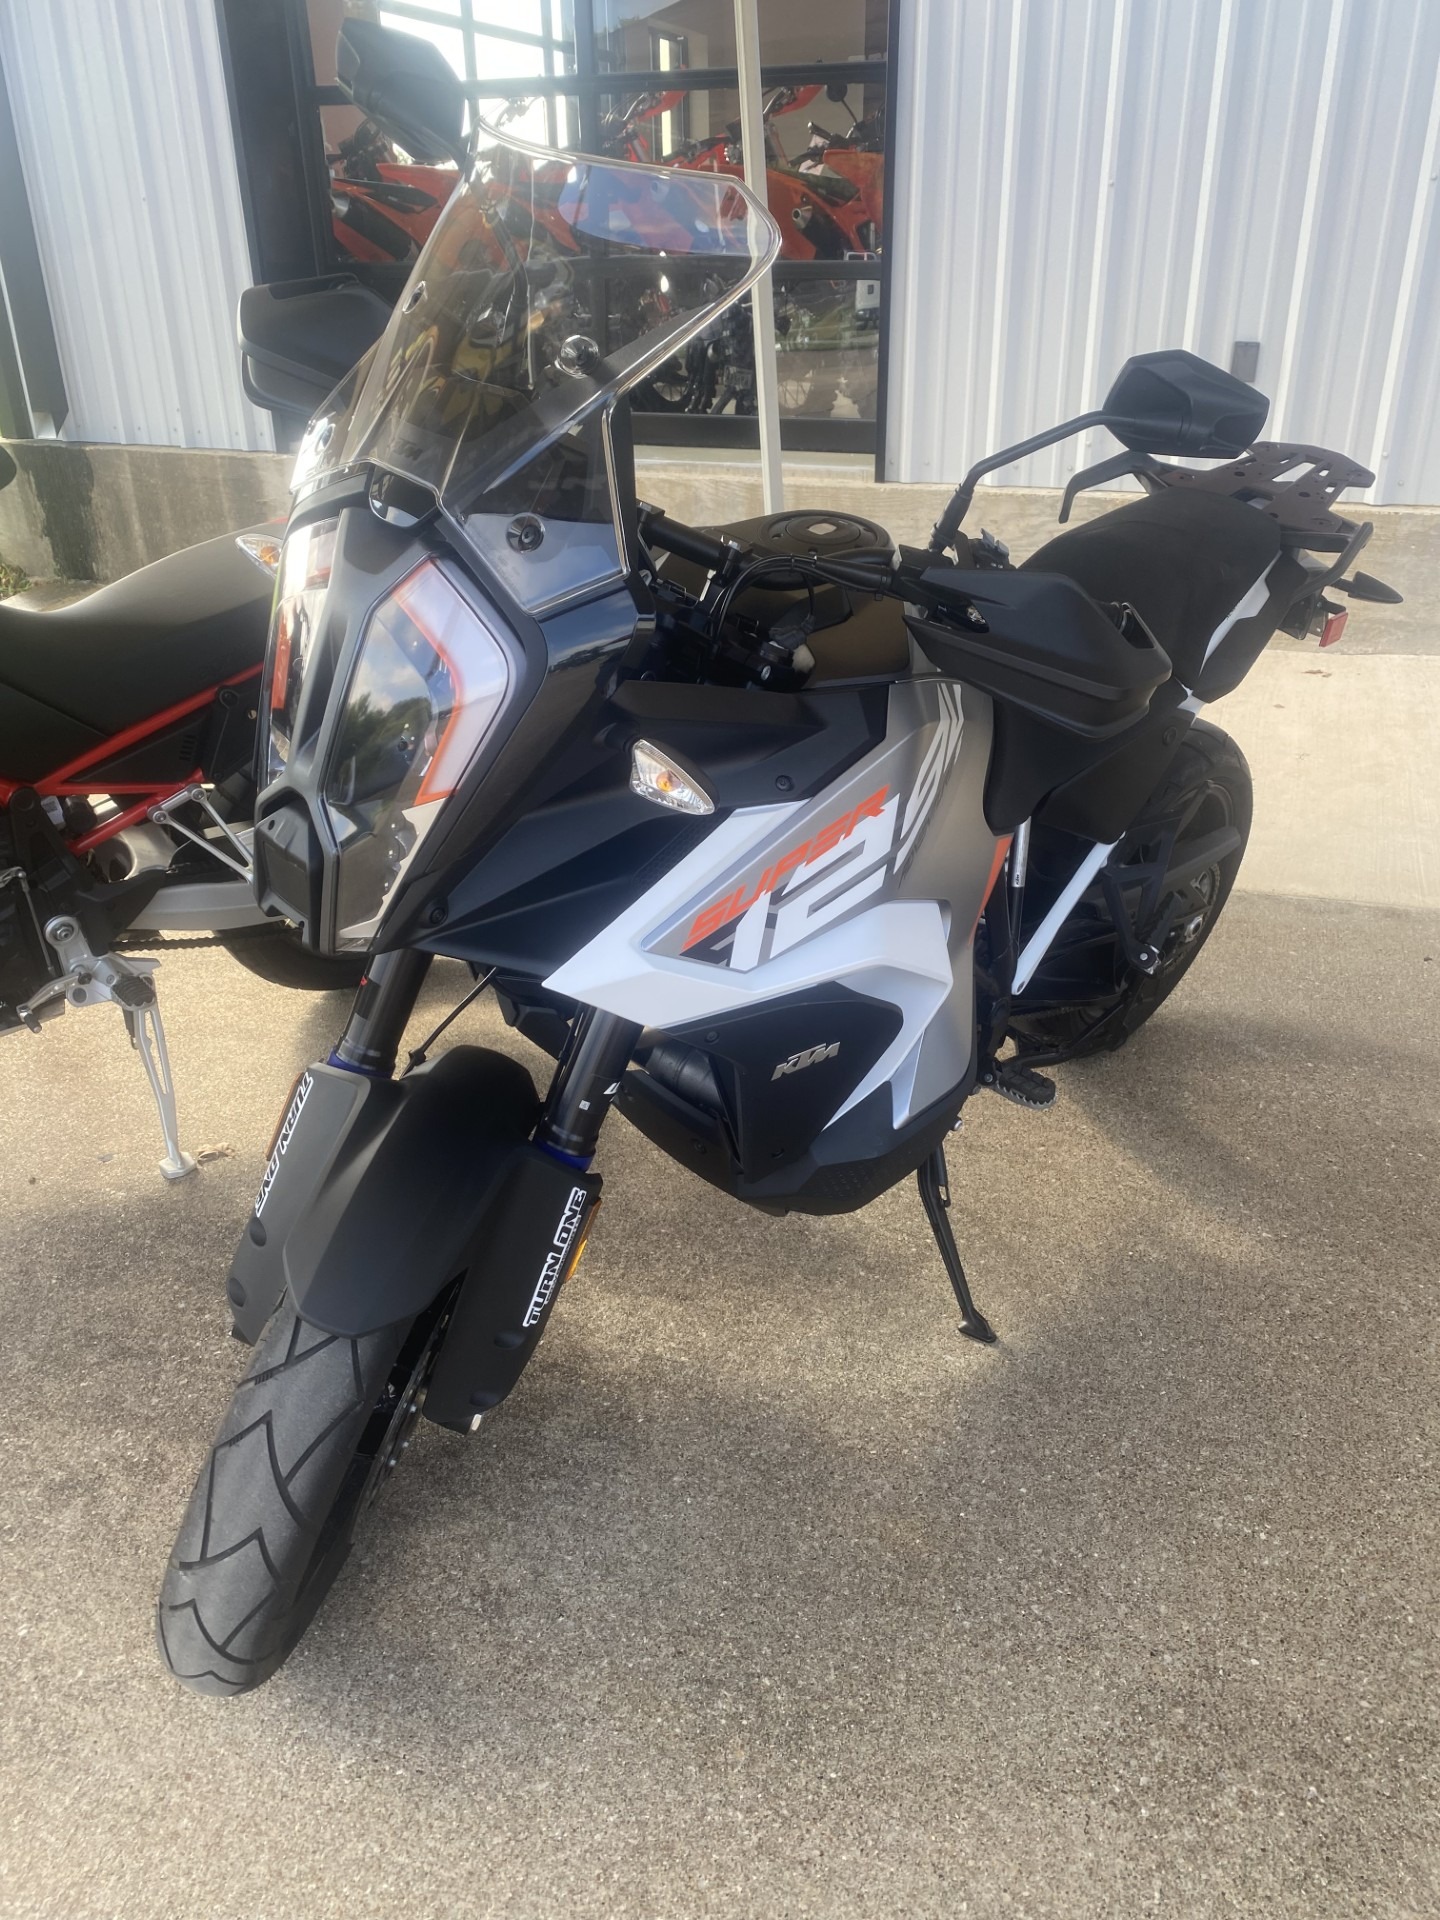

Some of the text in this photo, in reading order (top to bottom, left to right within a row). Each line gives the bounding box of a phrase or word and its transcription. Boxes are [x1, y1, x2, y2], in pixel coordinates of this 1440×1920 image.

[679, 784, 891, 955] SUPER
[770, 1041, 841, 1082] KTM
[254, 1071, 314, 1218] TURN ONE
[522, 1251, 563, 1328] TURN
[553, 1186, 588, 1248] ONE
